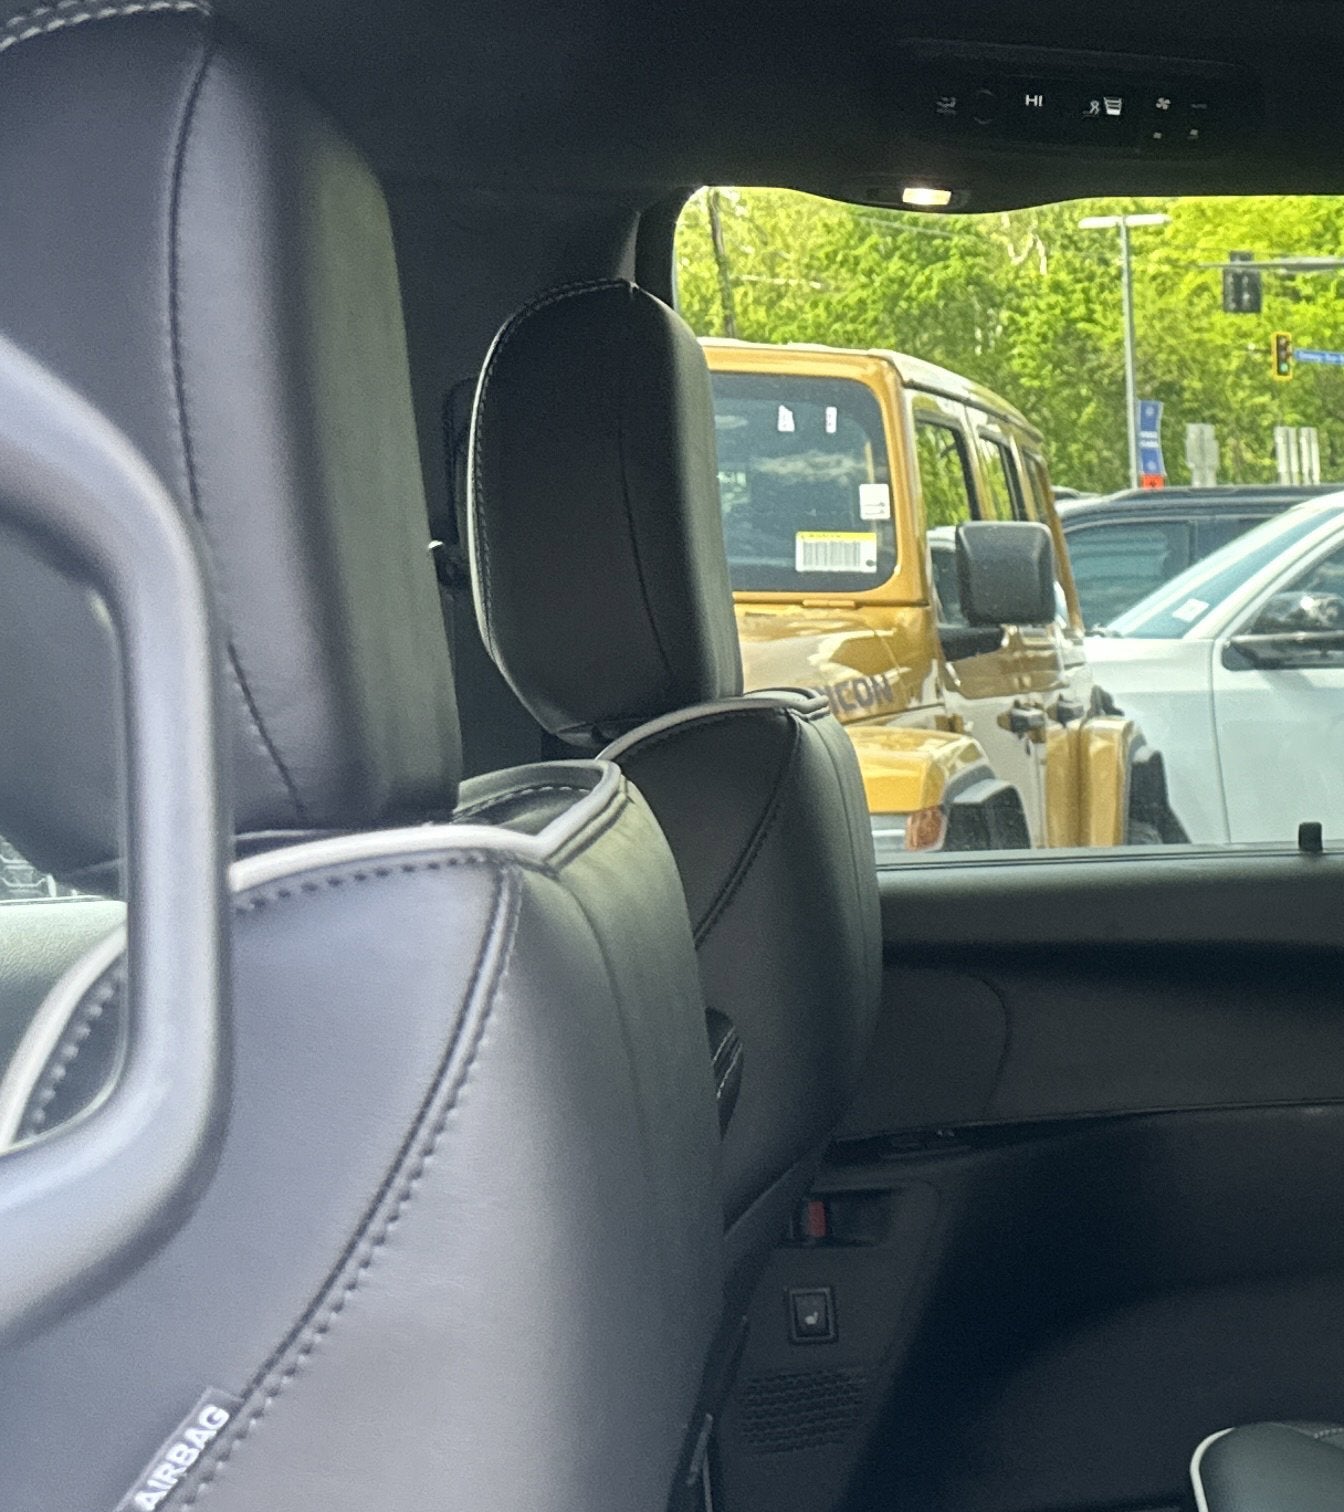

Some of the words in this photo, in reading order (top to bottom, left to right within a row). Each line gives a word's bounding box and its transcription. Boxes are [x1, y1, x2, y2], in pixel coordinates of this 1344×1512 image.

[1025, 94, 1043, 107] HI
[815, 673, 894, 717] ICON
[134, 1403, 231, 1512] AIRBAG
